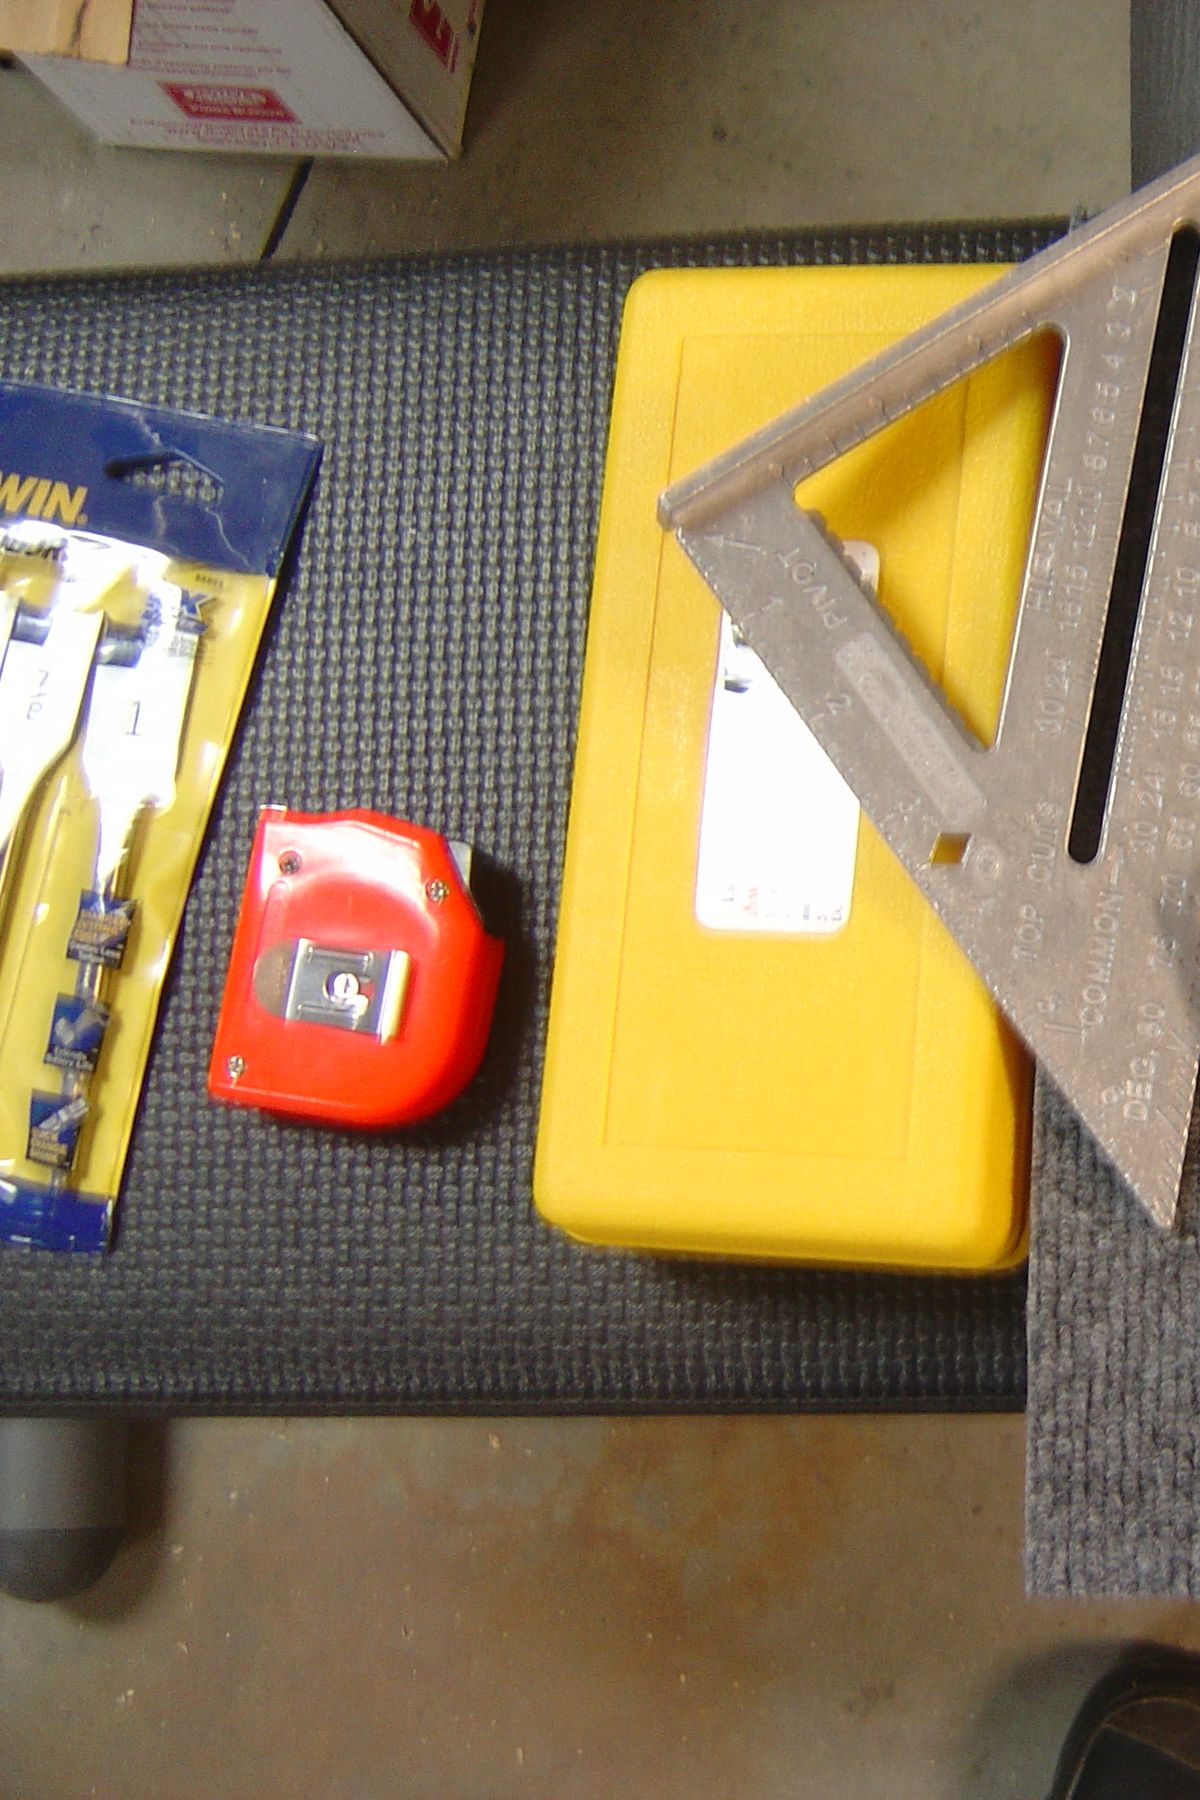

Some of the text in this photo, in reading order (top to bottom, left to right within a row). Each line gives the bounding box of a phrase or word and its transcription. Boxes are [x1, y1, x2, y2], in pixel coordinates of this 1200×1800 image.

[776, 546, 849, 631] PIVOT
[1012, 800, 1062, 961] TOP CUTS
[1080, 890, 1124, 1027] COMMON
